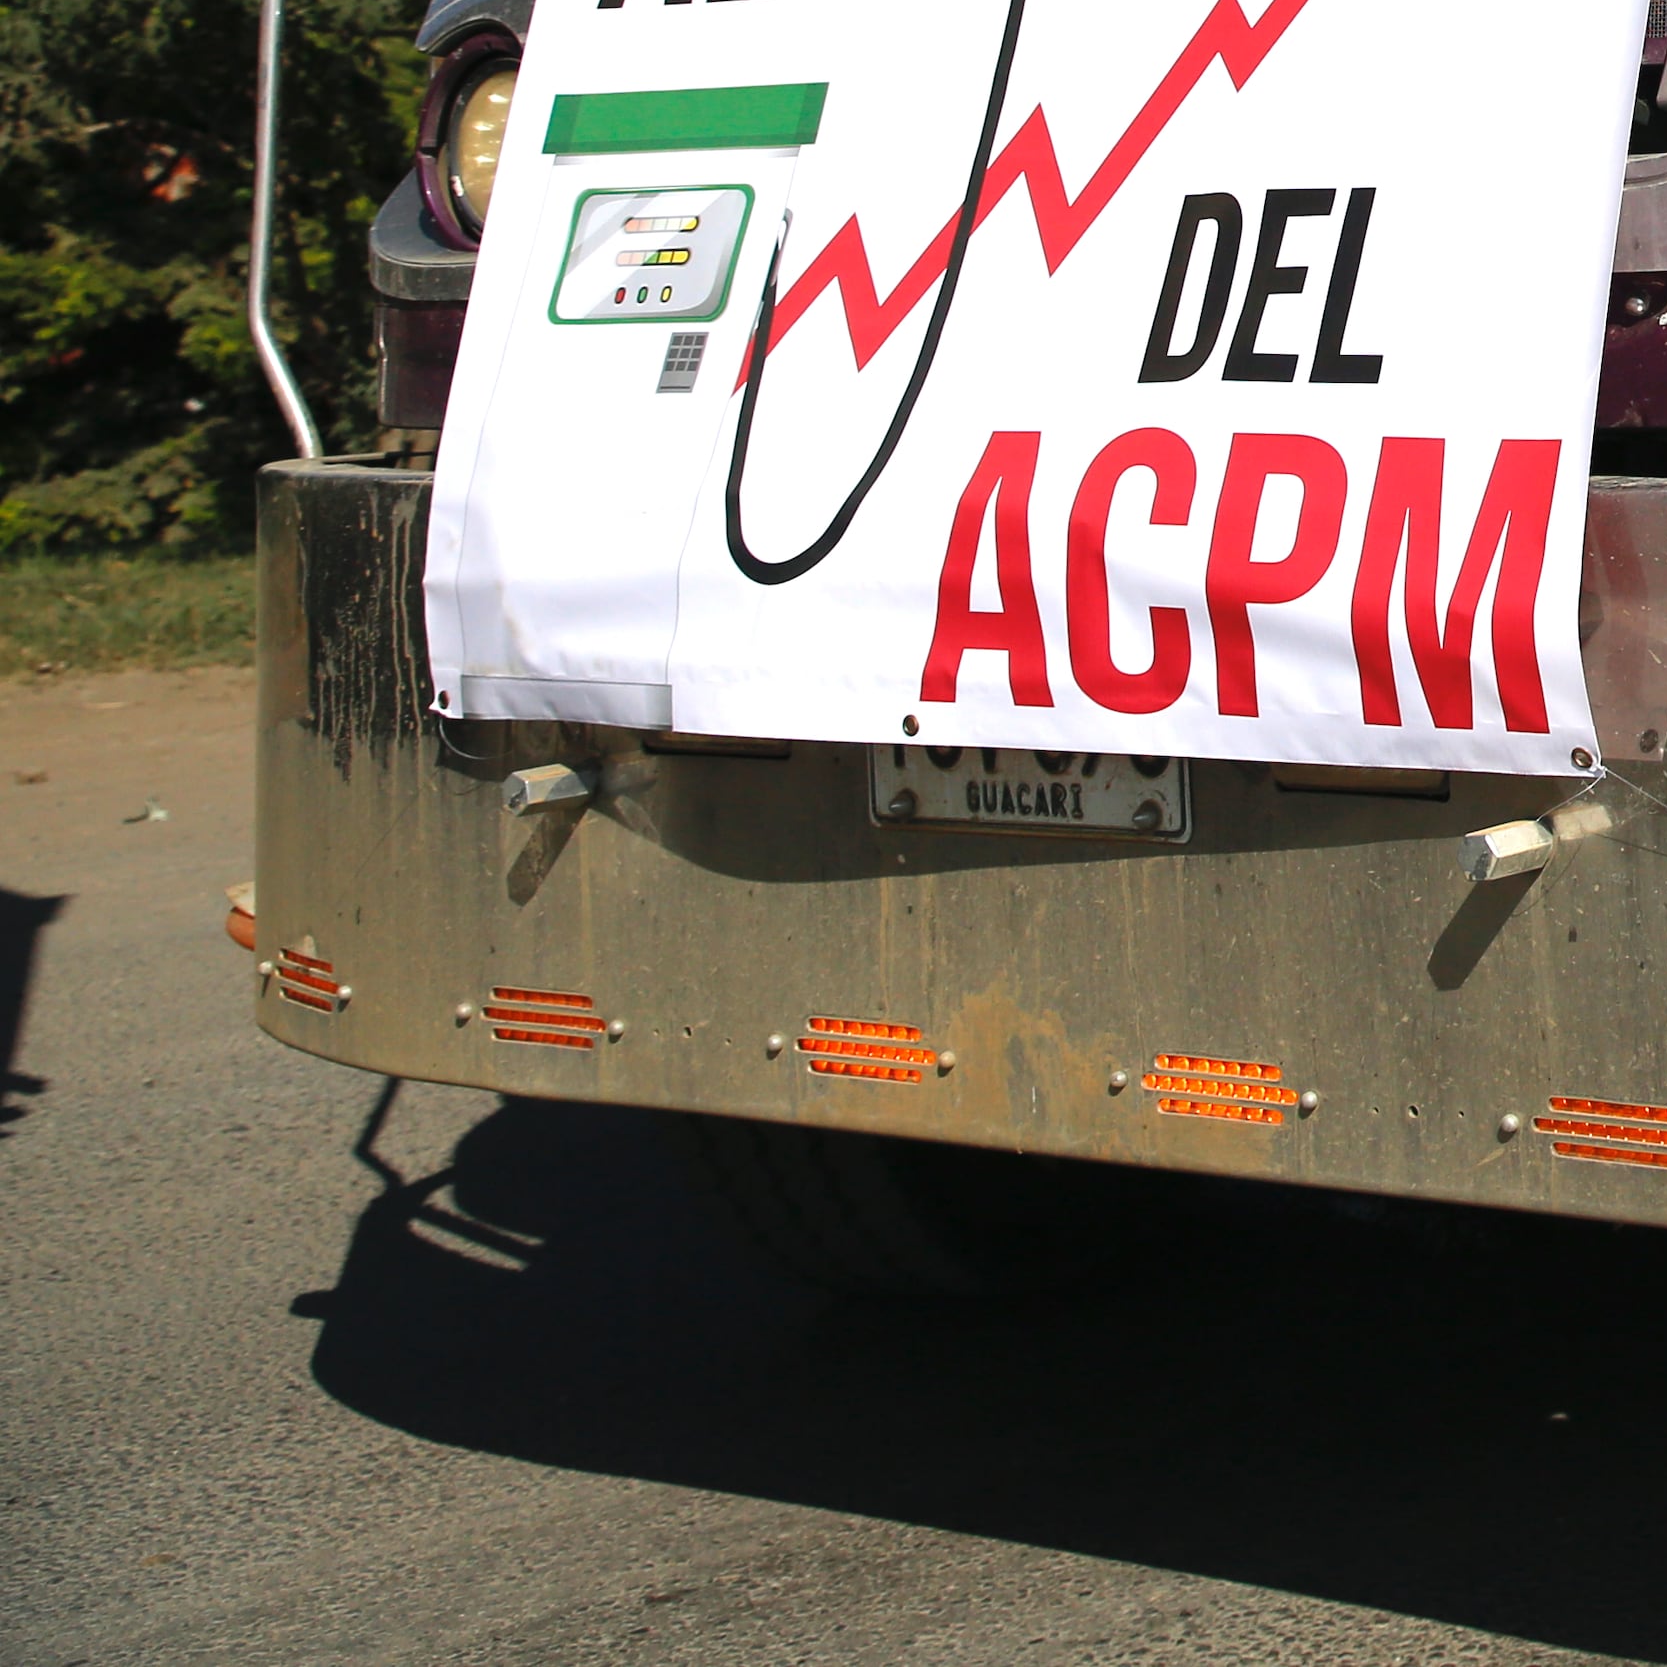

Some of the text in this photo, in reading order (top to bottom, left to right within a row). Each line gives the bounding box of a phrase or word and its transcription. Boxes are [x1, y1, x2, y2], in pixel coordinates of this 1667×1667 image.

[1138, 188, 1383, 383] DEL
[920, 426, 1561, 733] ACPM
[966, 780, 1084, 819] GUACARI
